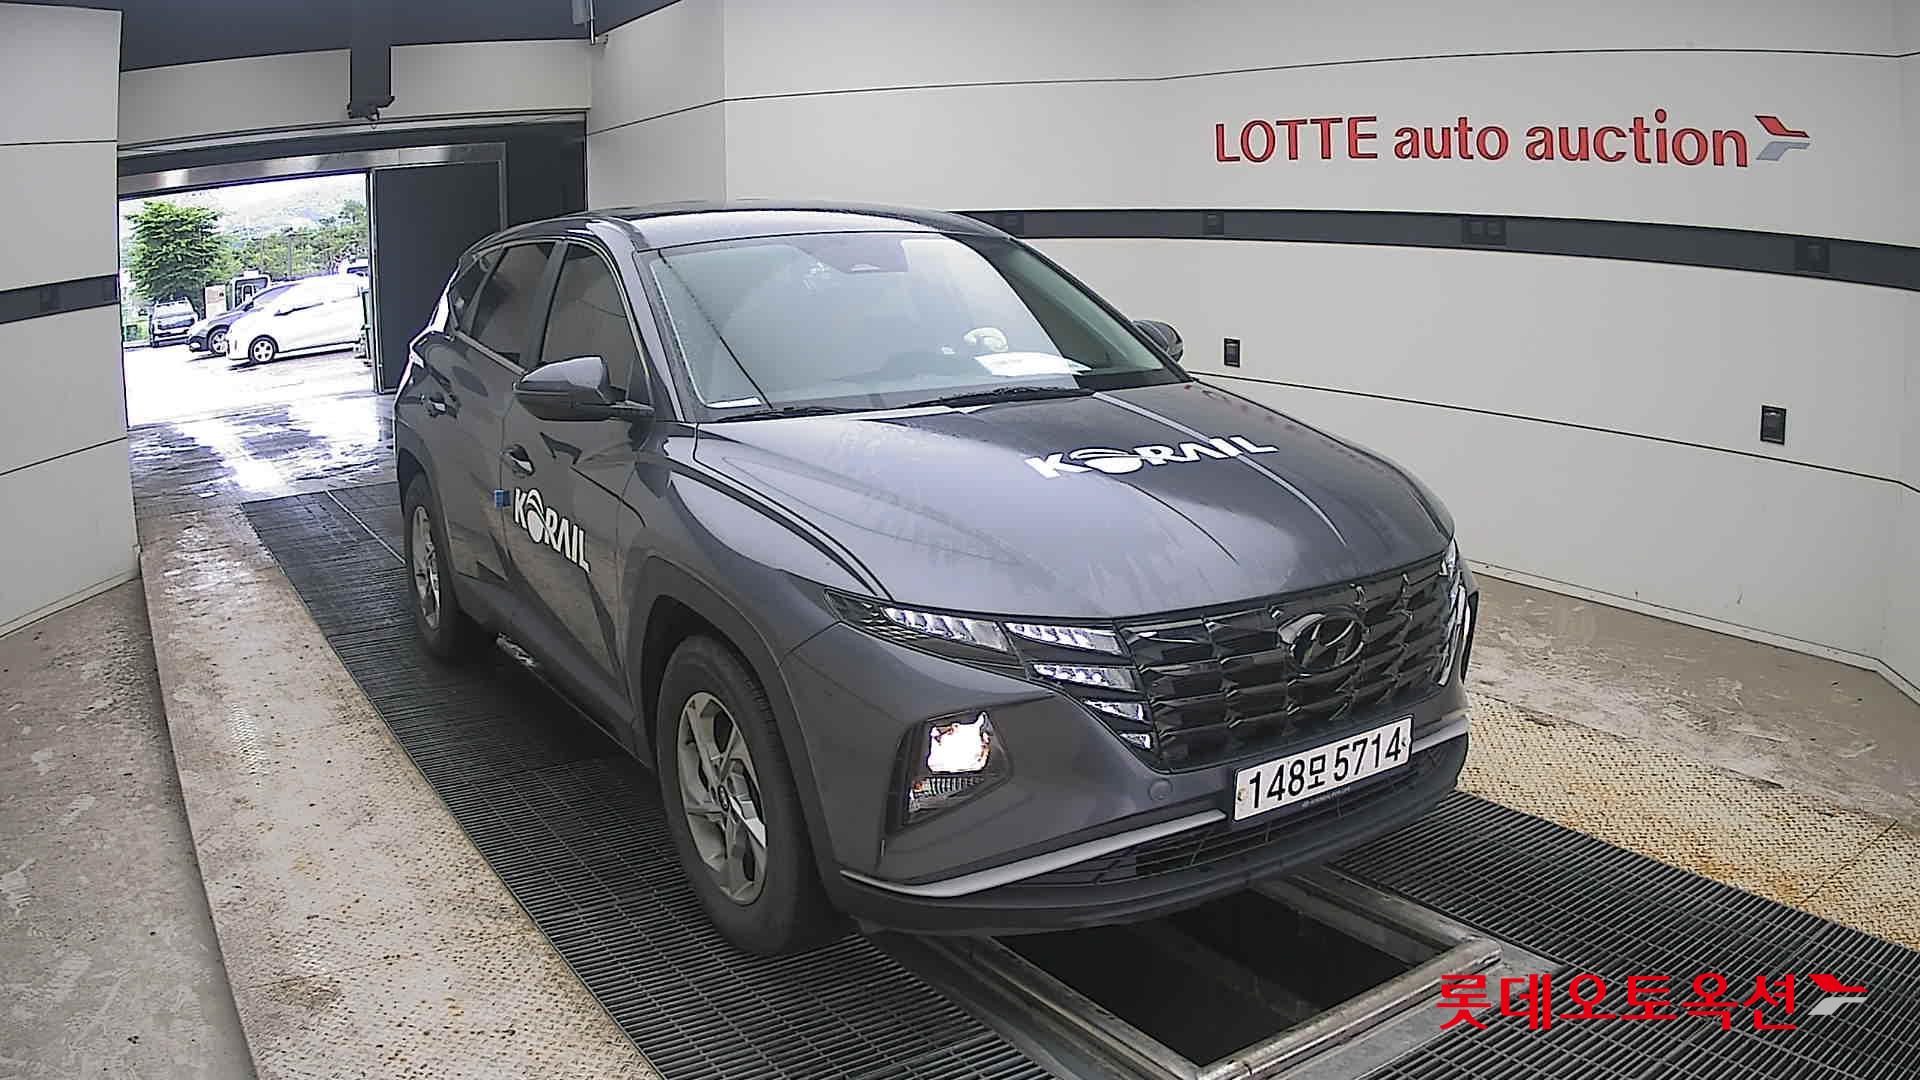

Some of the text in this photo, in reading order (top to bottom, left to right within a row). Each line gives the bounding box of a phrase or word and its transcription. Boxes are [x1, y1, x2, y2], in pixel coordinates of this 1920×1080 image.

[1214, 108, 1748, 167] LOTTE auto auction
[1023, 434, 1279, 479] KORAIL
[514, 487, 591, 575] KORAIL
